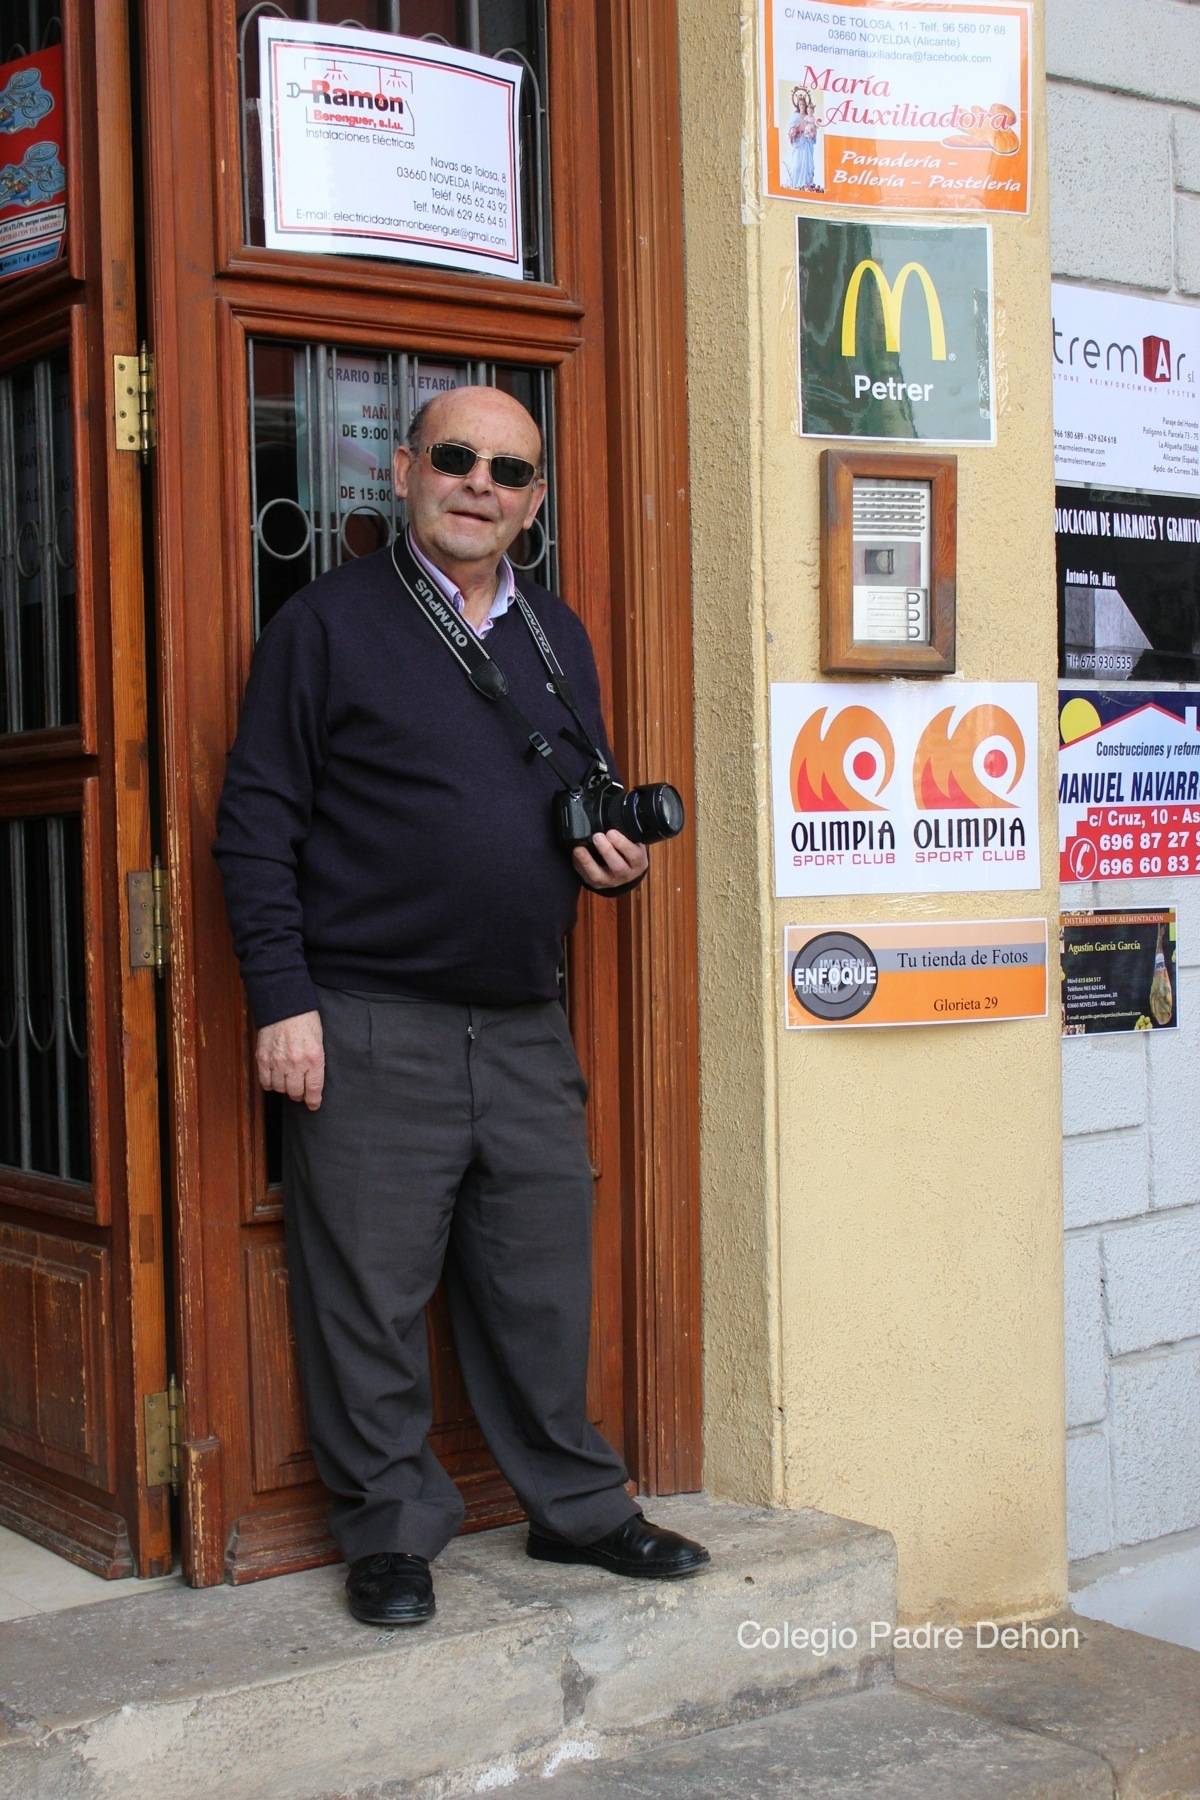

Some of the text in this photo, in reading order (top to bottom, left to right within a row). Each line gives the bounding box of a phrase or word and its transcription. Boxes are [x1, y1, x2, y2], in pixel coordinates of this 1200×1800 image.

[784, 8, 795, 19] C/
[797, 10, 829, 24] NAVAS
[832, 15, 847, 26] DE
[899, 21, 908, 32] 11
[920, 21, 939, 33] Telf.
[942, 22, 955, 33] 96
[959, 23, 976, 34] 560
[979, 24, 990, 34] 07
[993, 25, 1006, 35] 68
[828, 29, 960, 48] 03660 NOVELDA (Alicante)
[802, 65, 890, 97] María
[313, 109, 376, 128] Berenguer,
[815, 100, 1009, 130] Auxiliadora
[306, 128, 415, 150] Instalaciones Eléctricas
[431, 156, 458, 171] Navas
[461, 163, 472, 174] de
[502, 173, 507, 183] 8
[841, 150, 941, 169] Panadería
[396, 166, 507, 200] 03660 NOVELDA (Alicante)
[832, 170, 1021, 192] Bollería Pastelería
[456, 193, 472, 205] 965
[475, 198, 484, 208] 62
[487, 200, 496, 211] 43
[498, 202, 507, 214] 92
[296, 208, 331, 220] E-mail:
[413, 200, 507, 229] Telf. Móvil 629 65 64 51
[327, 367, 369, 384] ORARIO
[374, 372, 388, 385] DE
[854, 374, 934, 401] Petrer
[1090, 378, 1158, 393] REINFORCEMENT
[1167, 389, 1196, 399] SYSTEM
[342, 424, 357, 438] DE
[361, 426, 388, 441] 9:00
[1163, 453, 1181, 462] Alicante
[369, 467, 392, 481] TAR
[340, 486, 356, 500] DE
[1100, 511, 1111, 537] DE
[1113, 513, 1157, 540] MARMOLES
[1158, 516, 1164, 541] Y
[1066, 568, 1116, 587] Antonio Fco. Mira
[415, 579, 468, 648] OLYMPUS
[1081, 655, 1096, 669] 675
[1098, 655, 1114, 669] 930
[1116, 656, 1132, 670] 535
[1096, 741, 1164, 757] Construcciones
[1166, 745, 1172, 759] y
[1131, 771, 1200, 802] NAVARR
[1089, 811, 1103, 827] c/
[1107, 810, 1146, 829] Cruz,
[1151, 809, 1168, 825] 10
[791, 820, 895, 852] OLIMPIA
[913, 817, 1025, 849] OLIMPIA
[1100, 831, 1189, 851] 696 87 27
[793, 853, 896, 867] SPORT CLUB
[915, 850, 1026, 863] SPORT CLUB
[1100, 856, 1189, 876] 696 60 83
[1064, 915, 1109, 925] DISTRIBUIDOR
[1110, 915, 1118, 923] DE
[1068, 940, 1141, 955] Agustín García García
[820, 958, 864, 968] IMAGEN
[897, 949, 1028, 968] Tu tienda de Fotos
[794, 966, 876, 986] ENFOQUE
[933, 996, 998, 1012] Glorieta 29
